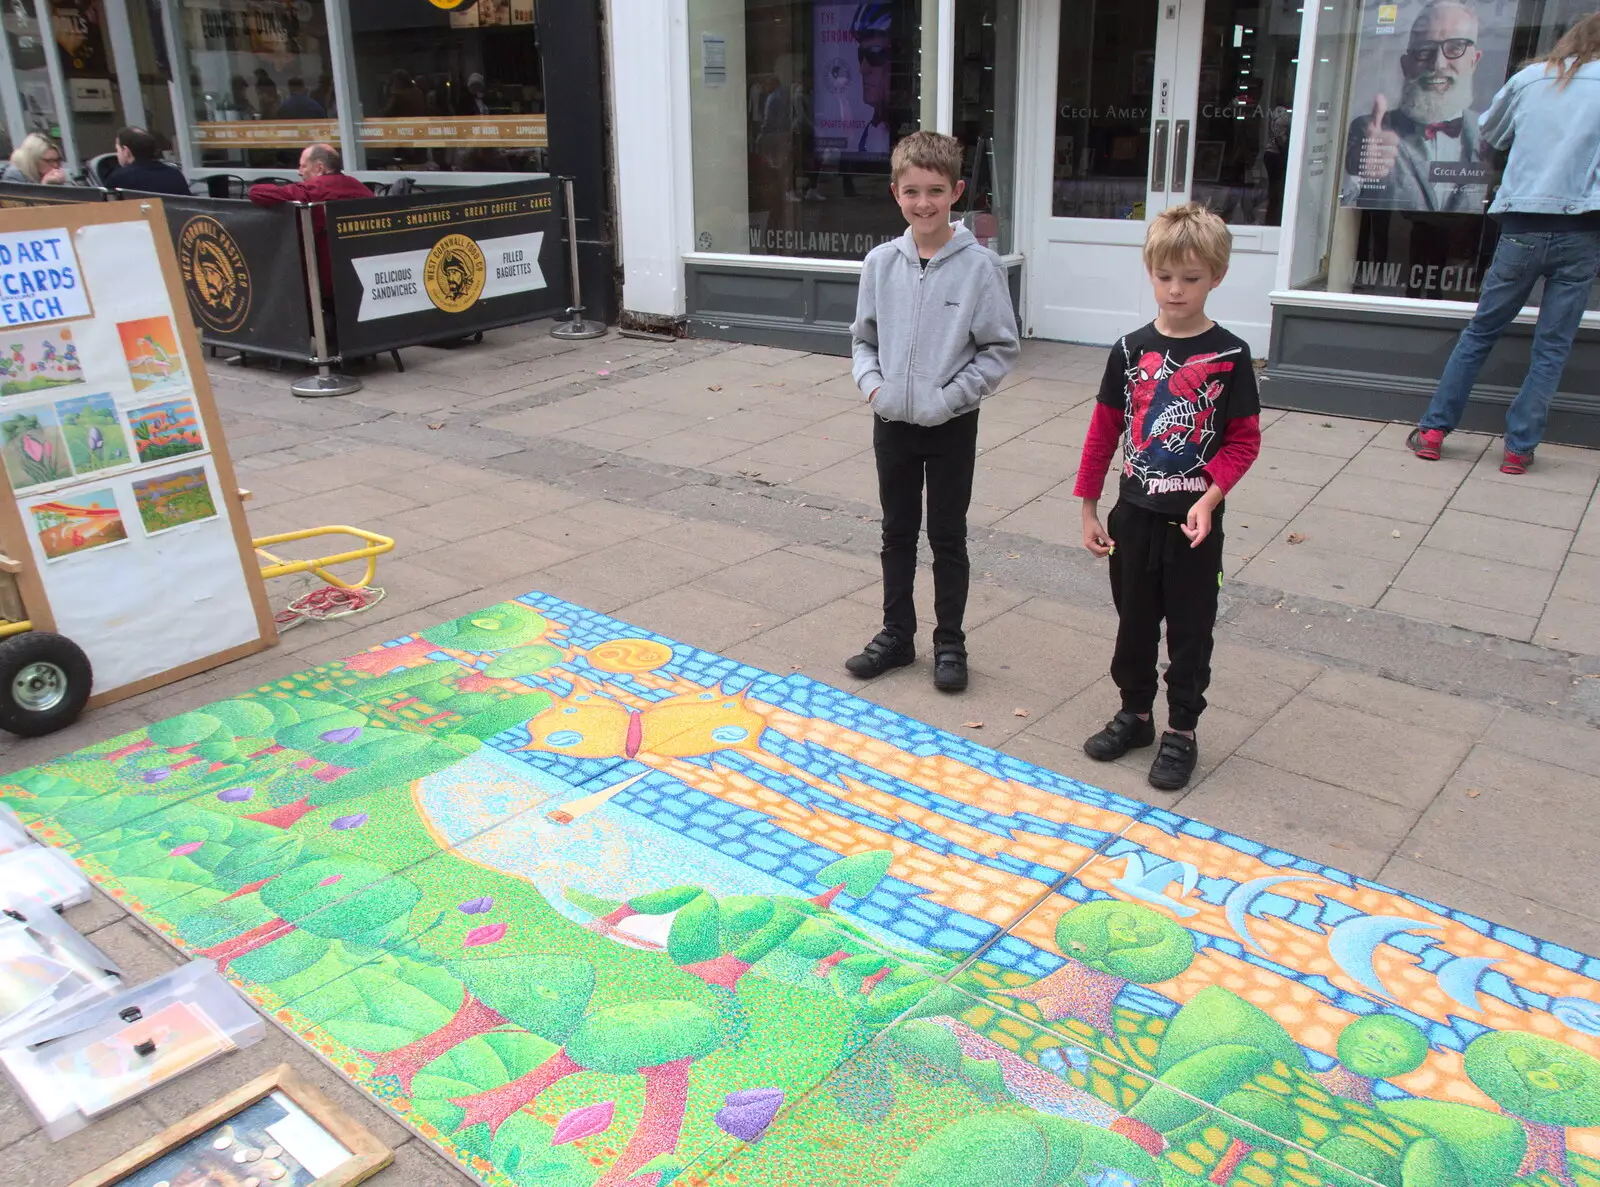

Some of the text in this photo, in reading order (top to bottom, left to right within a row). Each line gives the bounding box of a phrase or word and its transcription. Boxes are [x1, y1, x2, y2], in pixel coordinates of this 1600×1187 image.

[336, 197, 552, 233] SANDWICHES SMOOTHIES GREAT COFFEE CAKES
[17, 238, 61, 264] ART
[427, 259, 437, 281] WEST
[433, 238, 465, 259] CORNWALL
[466, 242, 480, 260] FOOD
[502, 250, 524, 264] FILLED
[374, 268, 412, 284] DELICIOUS
[496, 262, 532, 279] BAGUETTES
[371, 282, 418, 301] SANDWICHES
[2, 296, 64, 323] EACH
[1146, 476, 1209, 496] SPIDER-MAN
